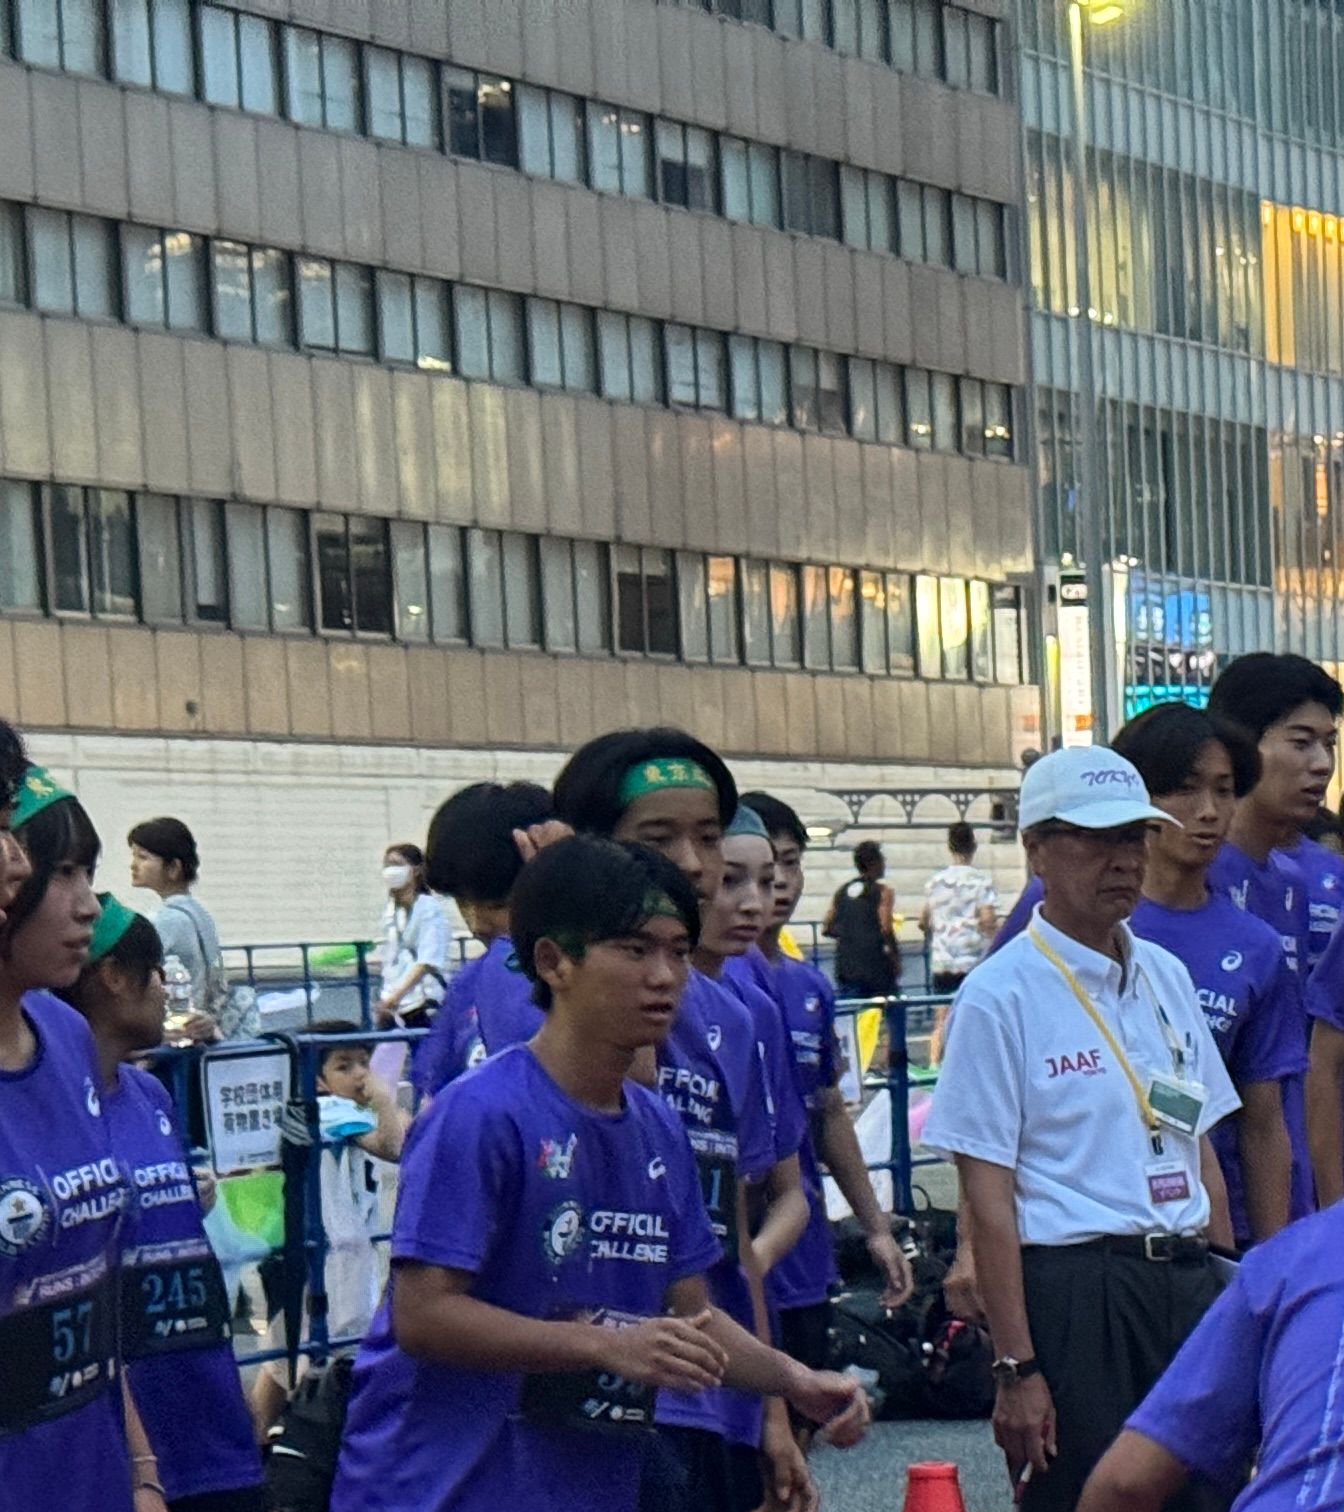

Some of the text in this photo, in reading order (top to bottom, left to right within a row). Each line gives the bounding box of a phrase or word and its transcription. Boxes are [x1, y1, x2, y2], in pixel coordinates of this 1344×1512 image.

[1045, 1048, 1101, 1079] JAAF
[141, 1268, 207, 1315] 245
[53, 1301, 93, 1361] 57
